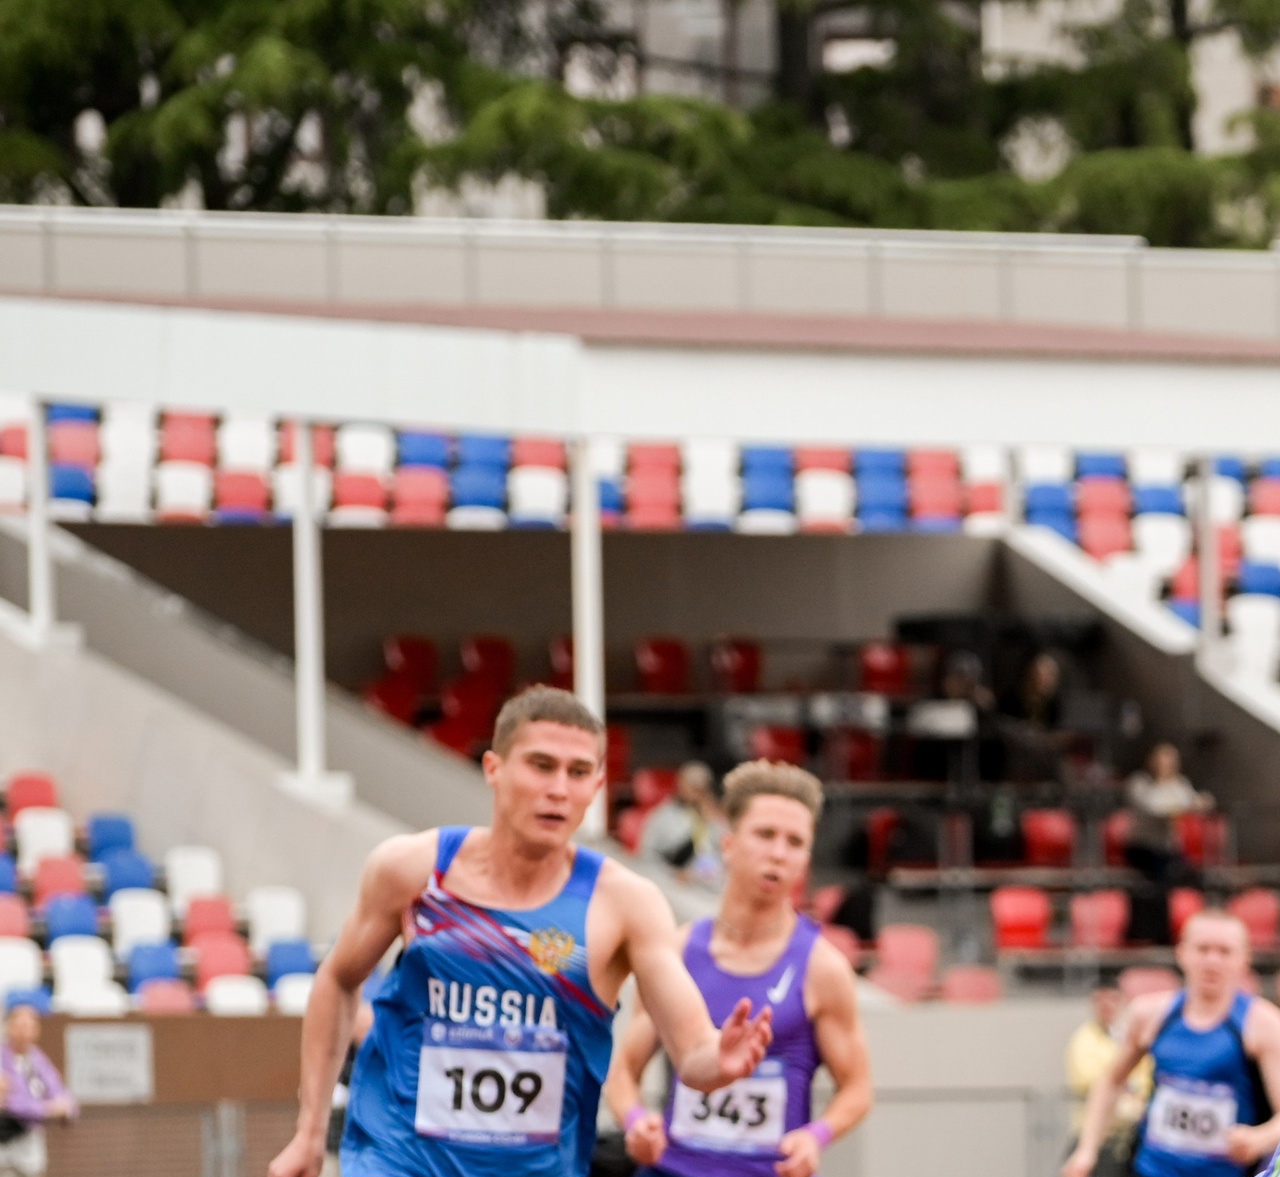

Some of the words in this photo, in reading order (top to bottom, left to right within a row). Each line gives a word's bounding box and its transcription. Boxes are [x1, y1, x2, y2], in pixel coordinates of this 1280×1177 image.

[428, 977, 559, 1029] RUSSIA
[444, 1067, 543, 1115] 109
[691, 1093, 768, 1127] 343
